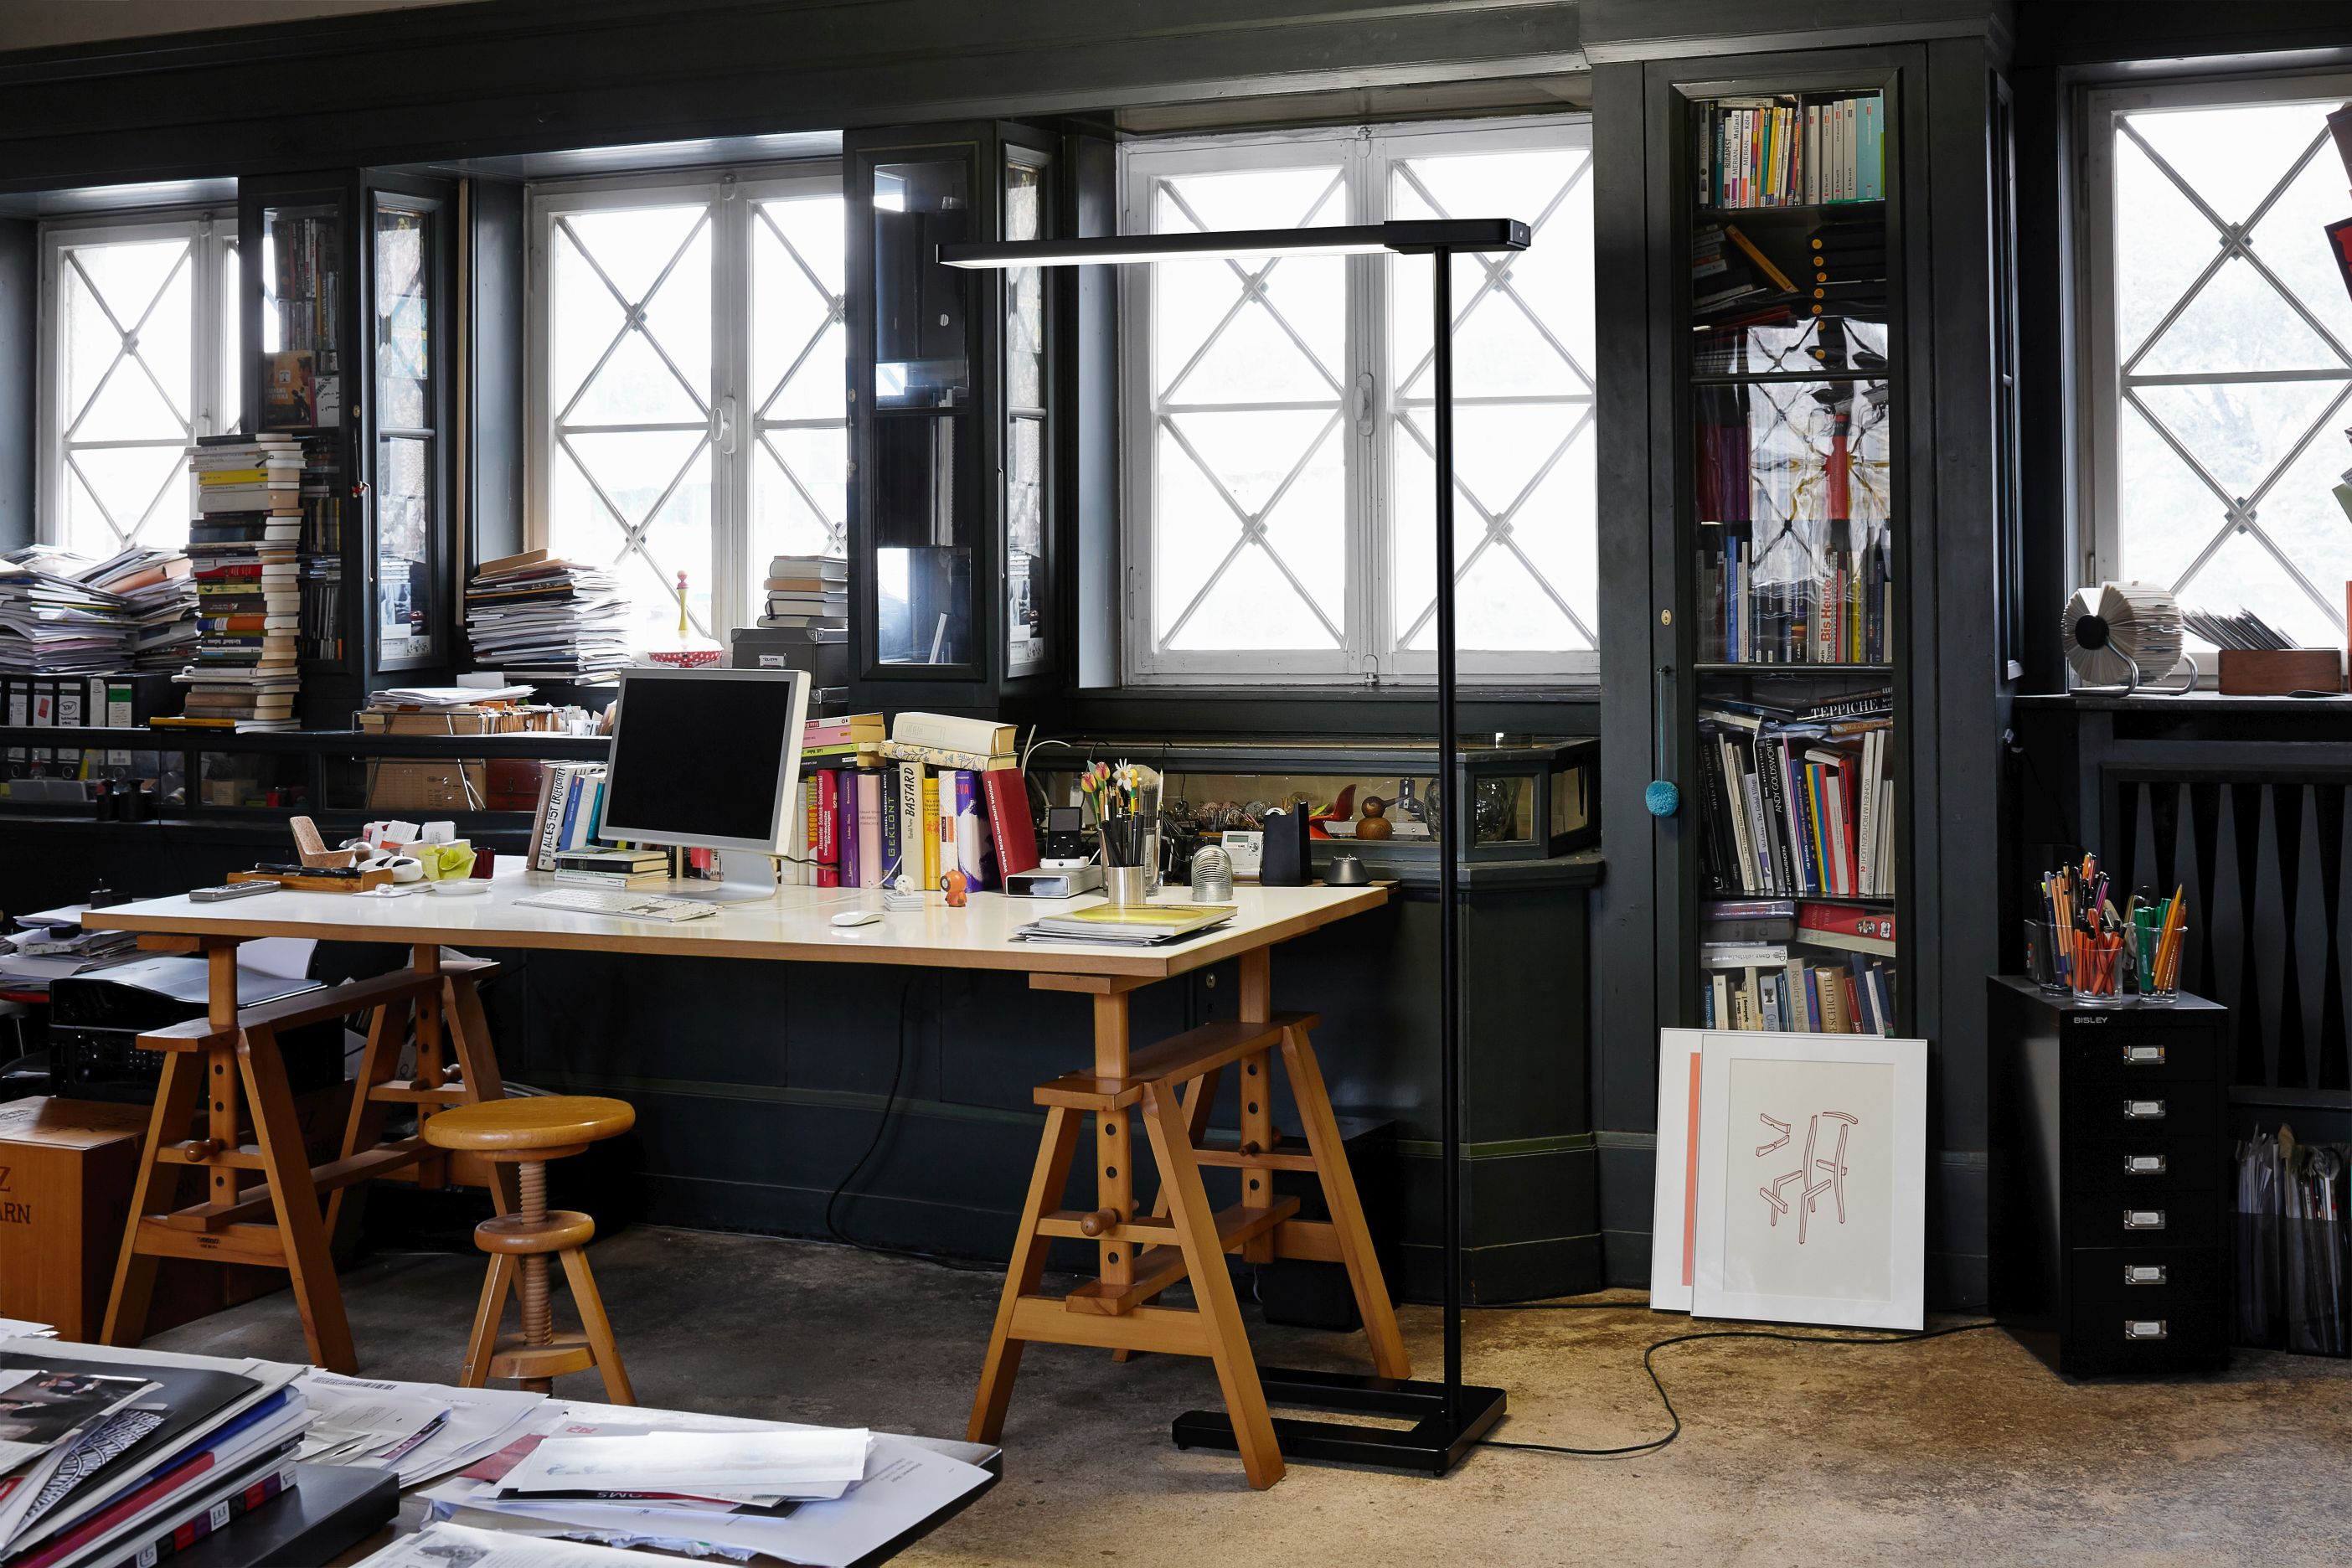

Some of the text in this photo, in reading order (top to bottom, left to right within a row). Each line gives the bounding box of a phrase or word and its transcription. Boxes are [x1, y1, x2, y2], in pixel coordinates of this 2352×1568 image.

[1820, 579, 1832, 642] Bis Heute
[1811, 699, 1878, 716] TEPPICHE
[1765, 731, 1782, 812] ANDY GOLDSWORTHY
[543, 823, 557, 848] ALLES
[550, 767, 566, 805] ERLEUCHTET
[904, 767, 915, 817] BASTARD
[987, 780, 995, 805] Wohlstand
[809, 812, 818, 842] DOBSON
[999, 850, 1008, 874] Wolfgang
[1782, 845, 1791, 885] ZWEITAUSENDEINS
[1792, 970, 1803, 1004] Reader's
[1823, 977, 1838, 1033] ESCHICHTE
[281, 1436, 300, 1451] Montana
